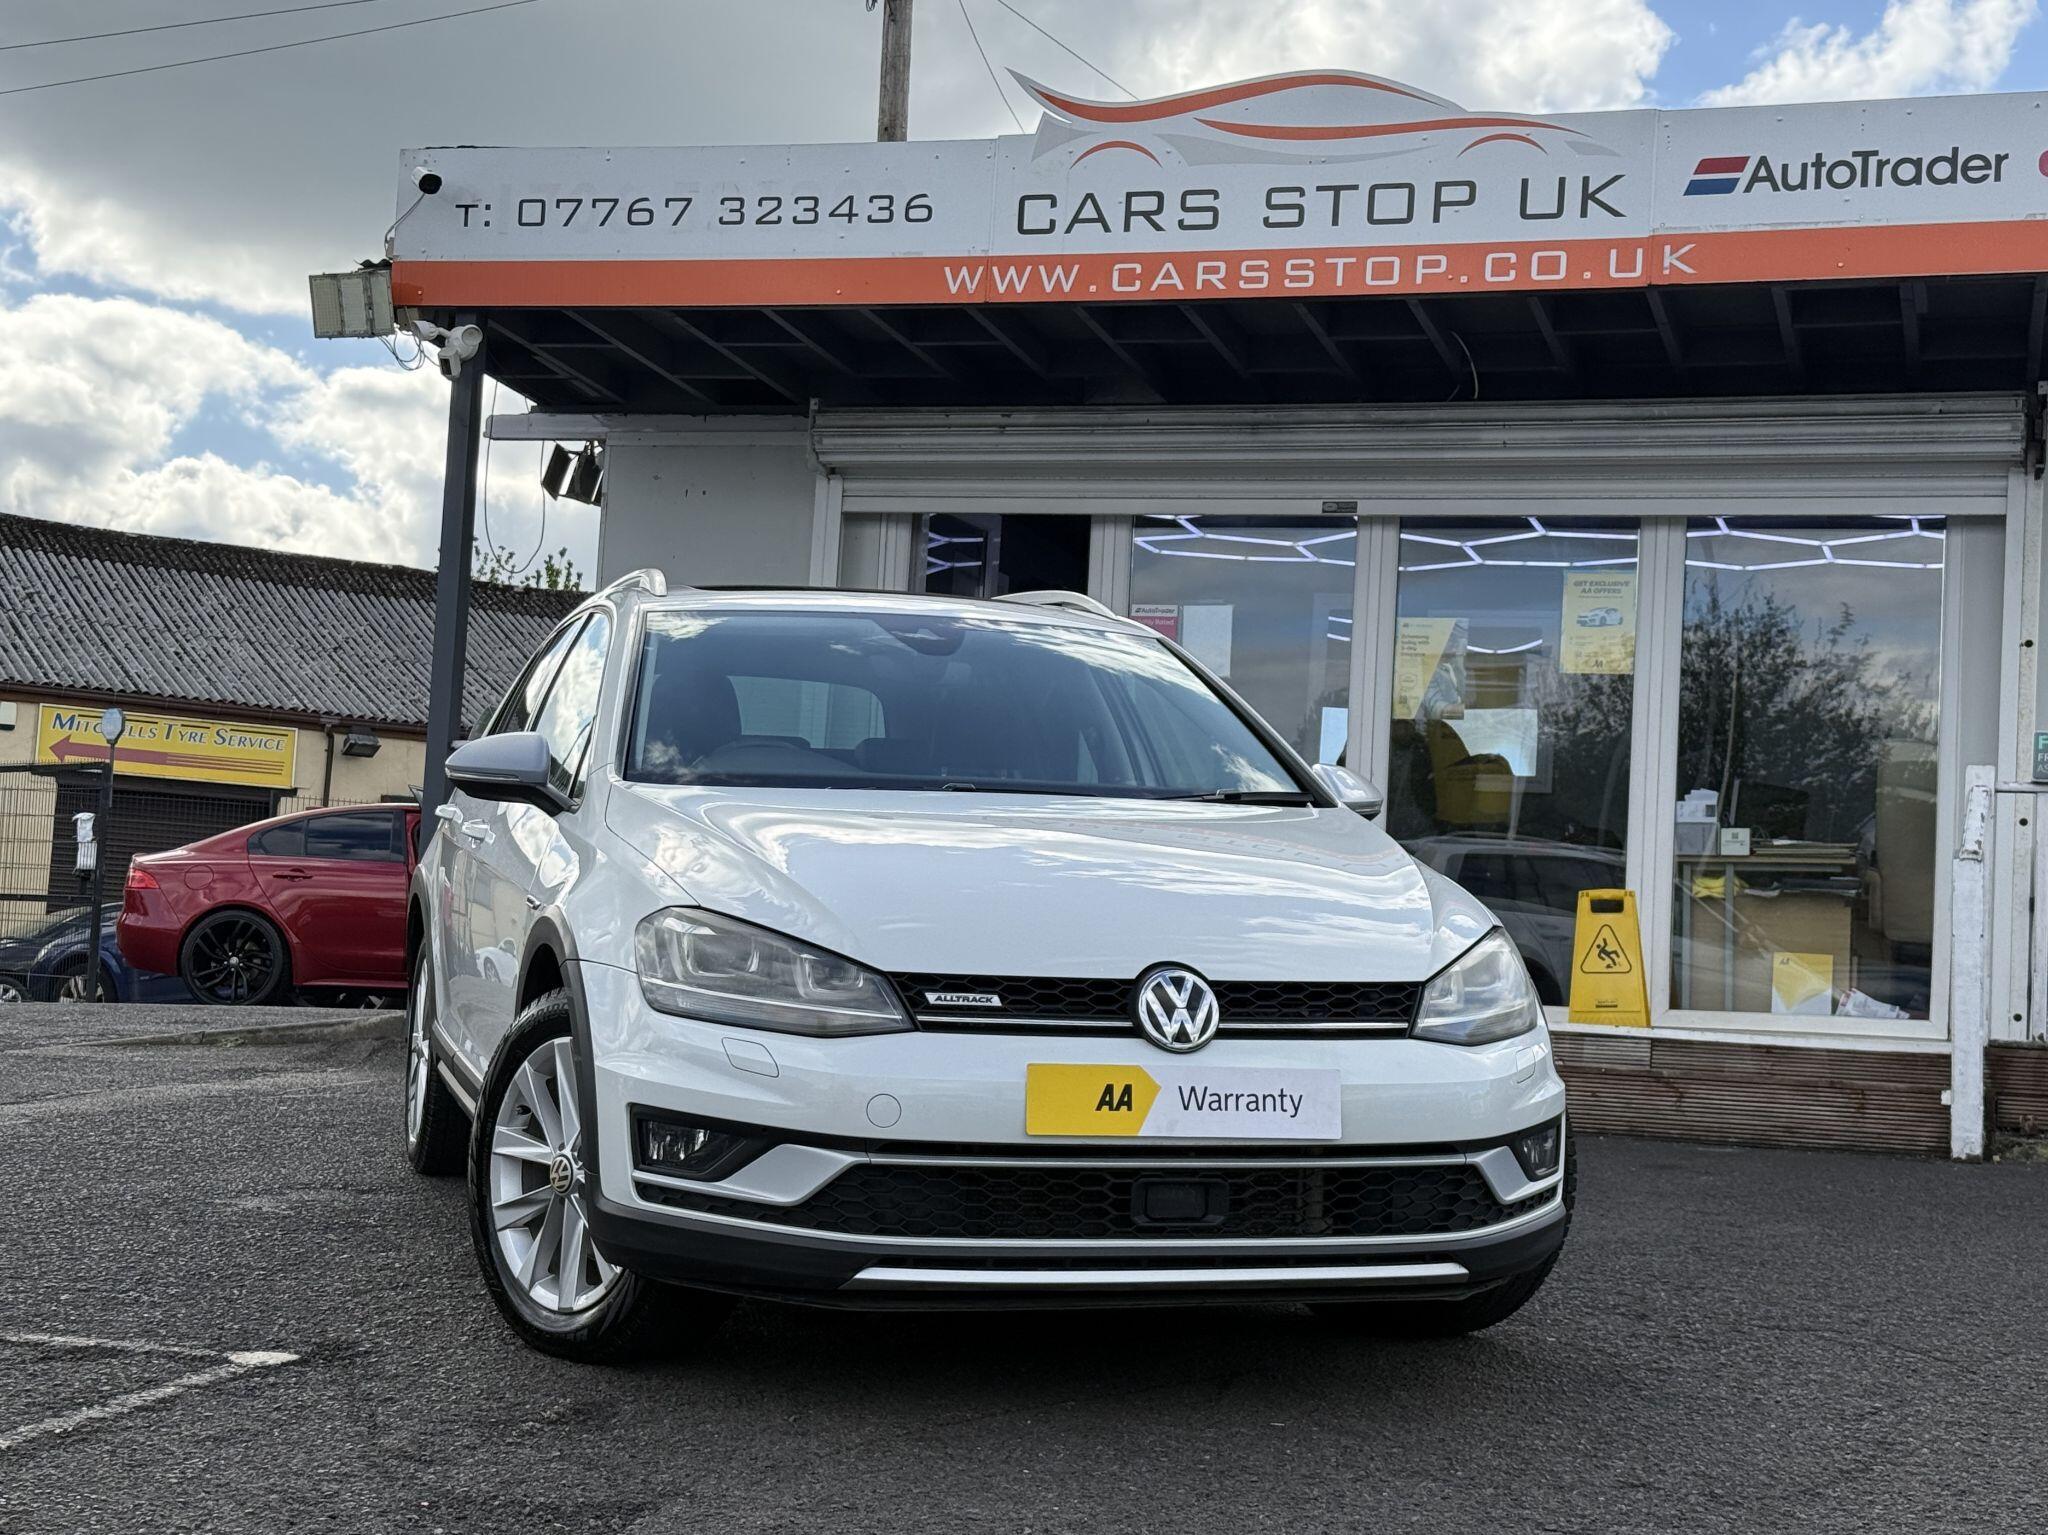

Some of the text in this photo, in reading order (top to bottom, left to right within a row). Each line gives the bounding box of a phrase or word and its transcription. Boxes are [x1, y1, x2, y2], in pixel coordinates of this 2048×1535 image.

[1742, 146, 2010, 194] AutoTrader
[455, 193, 933, 228] T: 07767 323436
[1017, 173, 1627, 236] CARS STOP UK
[943, 243, 1698, 296] WWW.CARSSTOP.CO.UK
[52, 711, 285, 751] MITCELLS TYRE SERVICE
[934, 994, 994, 1005] ALLTRACK
[1095, 1083, 1304, 1119] AA Warranty
